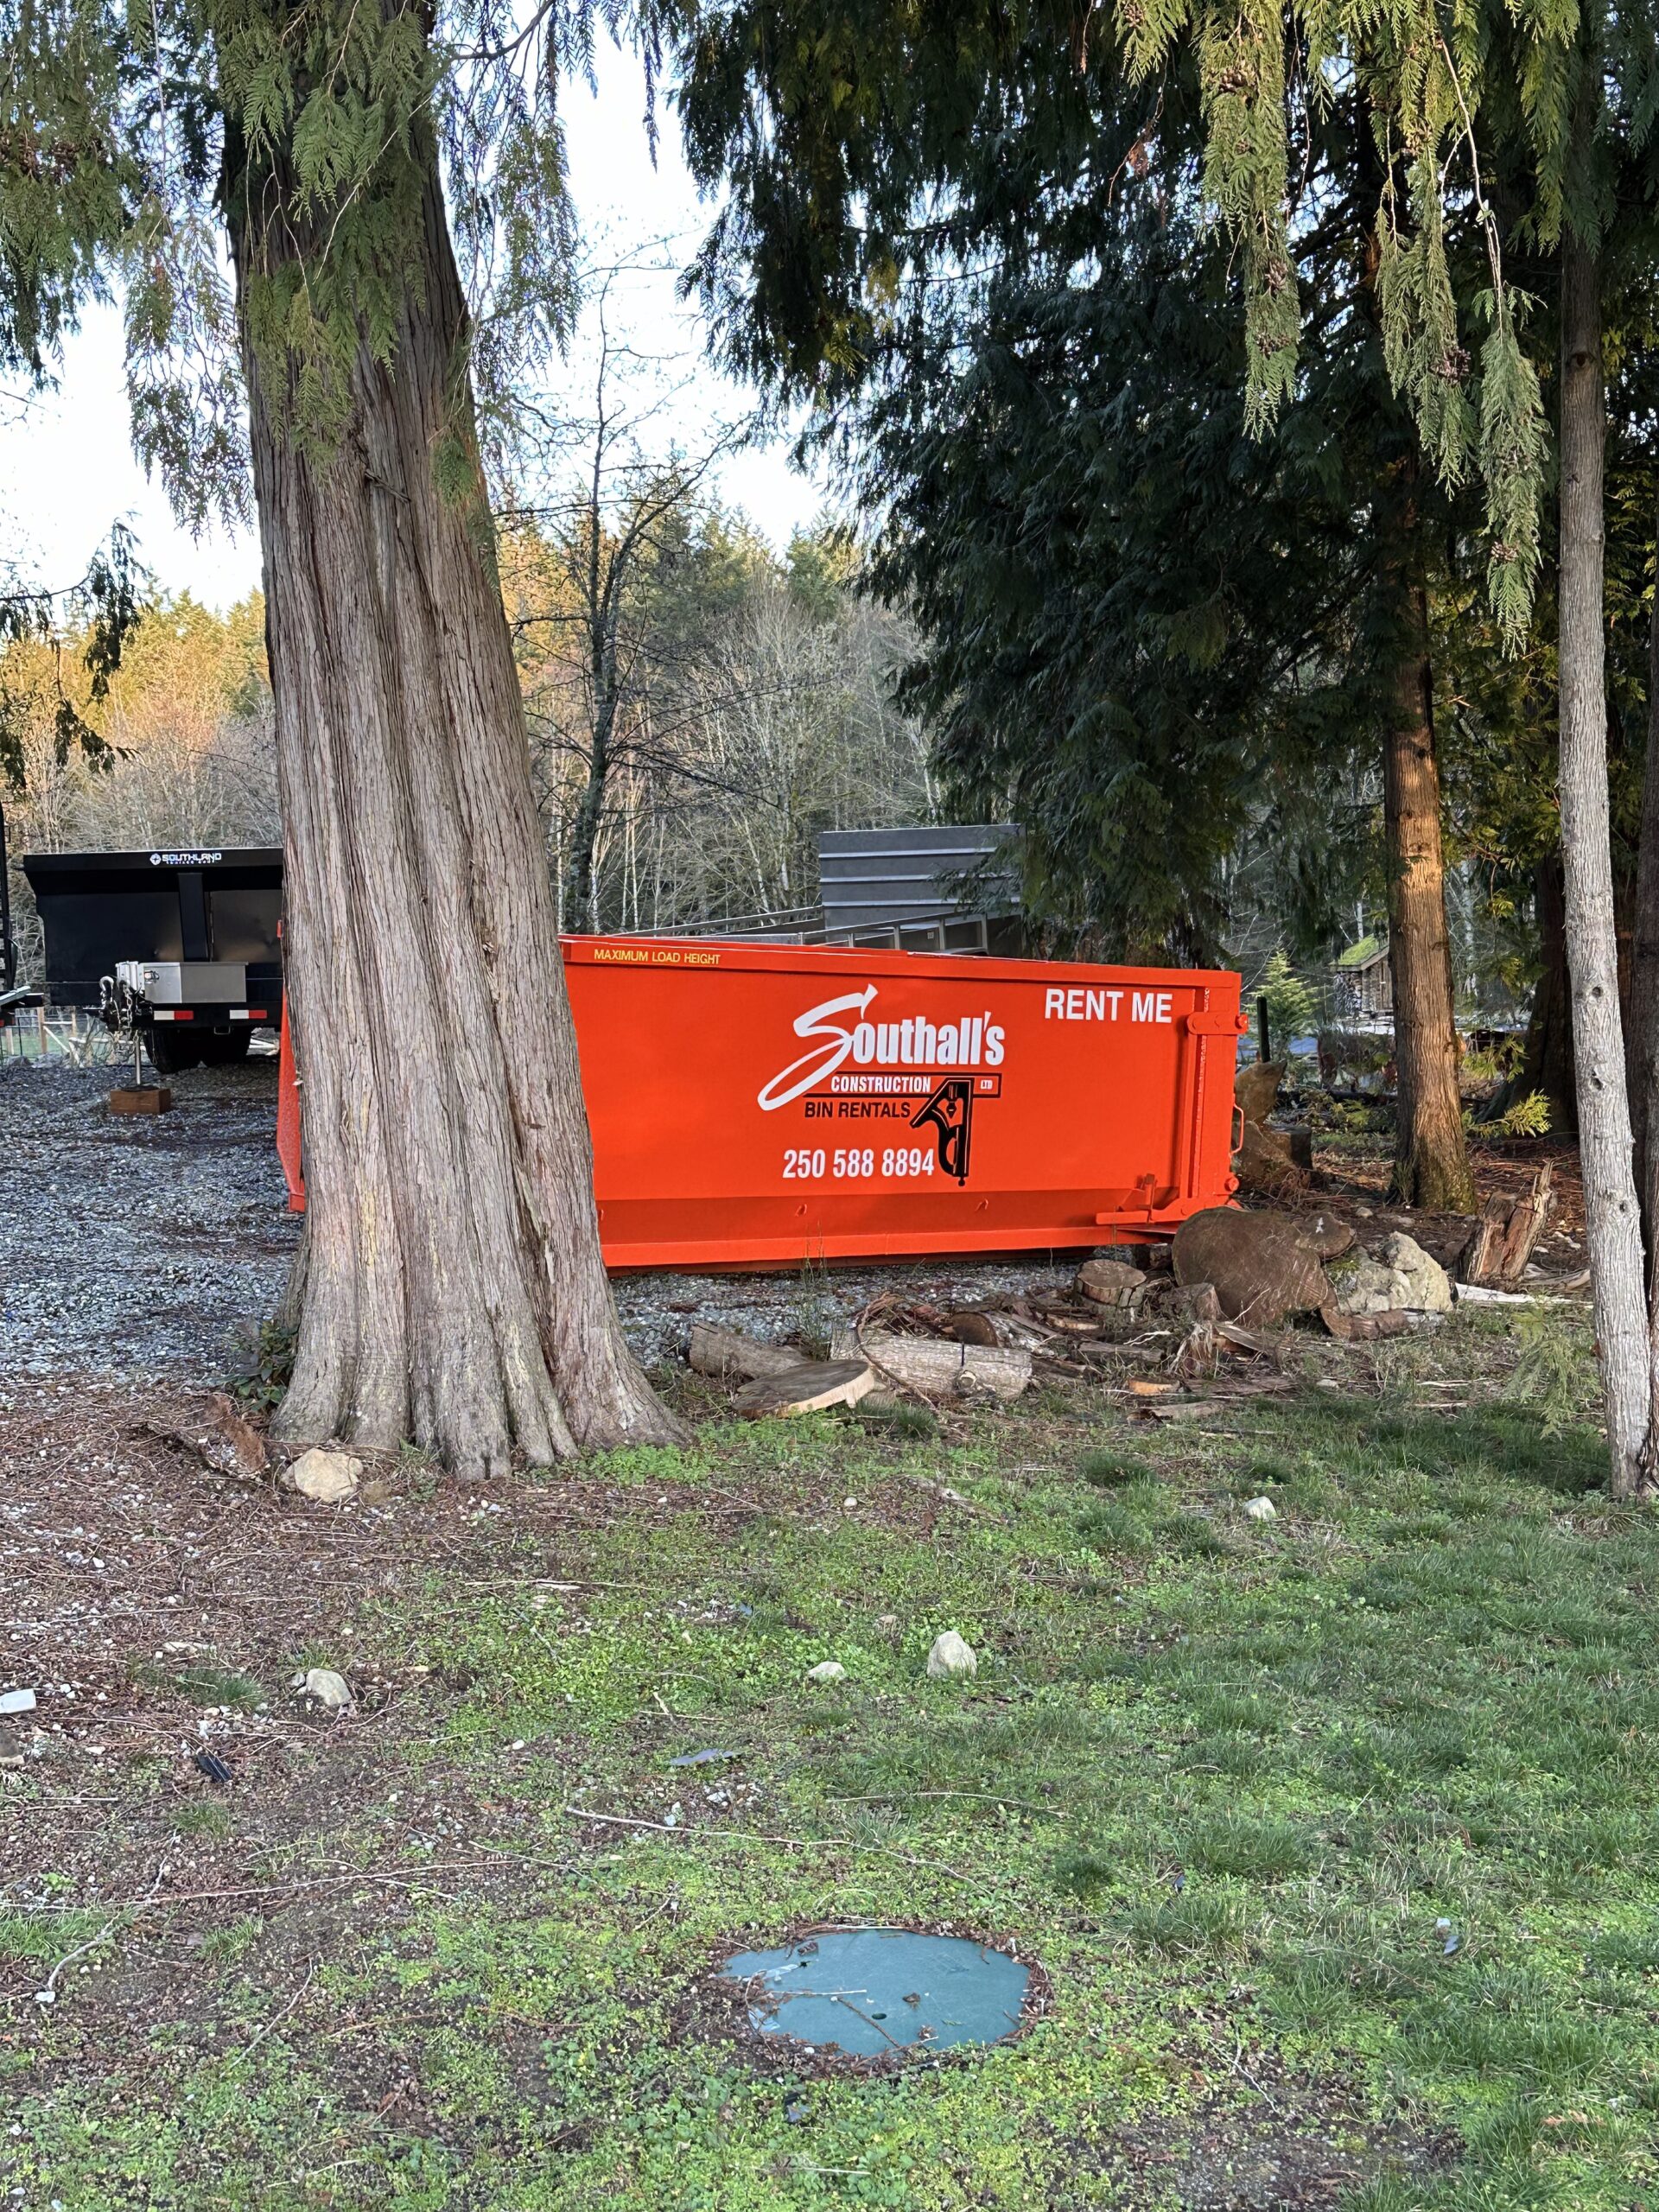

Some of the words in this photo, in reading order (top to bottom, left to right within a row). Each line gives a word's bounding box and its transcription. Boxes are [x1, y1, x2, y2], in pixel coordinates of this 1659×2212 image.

[162, 853, 222, 862] SOUTHLAND
[594, 949, 648, 962] MAXIMUM
[652, 951, 680, 963] LOAD
[683, 953, 721, 964] HEIGHT
[1045, 988, 1124, 1021] RENT
[1131, 992, 1173, 1023] ME
[757, 983, 1006, 1111] Southall's
[831, 1076, 931, 1093] CONSTRUCTION
[980, 1079, 993, 1090] LTD
[804, 1102, 833, 1118] BIN
[838, 1102, 911, 1118] RENTALS
[782, 1149, 826, 1179] 250
[832, 1148, 874, 1178] 588
[881, 1147, 935, 1177] 8894
